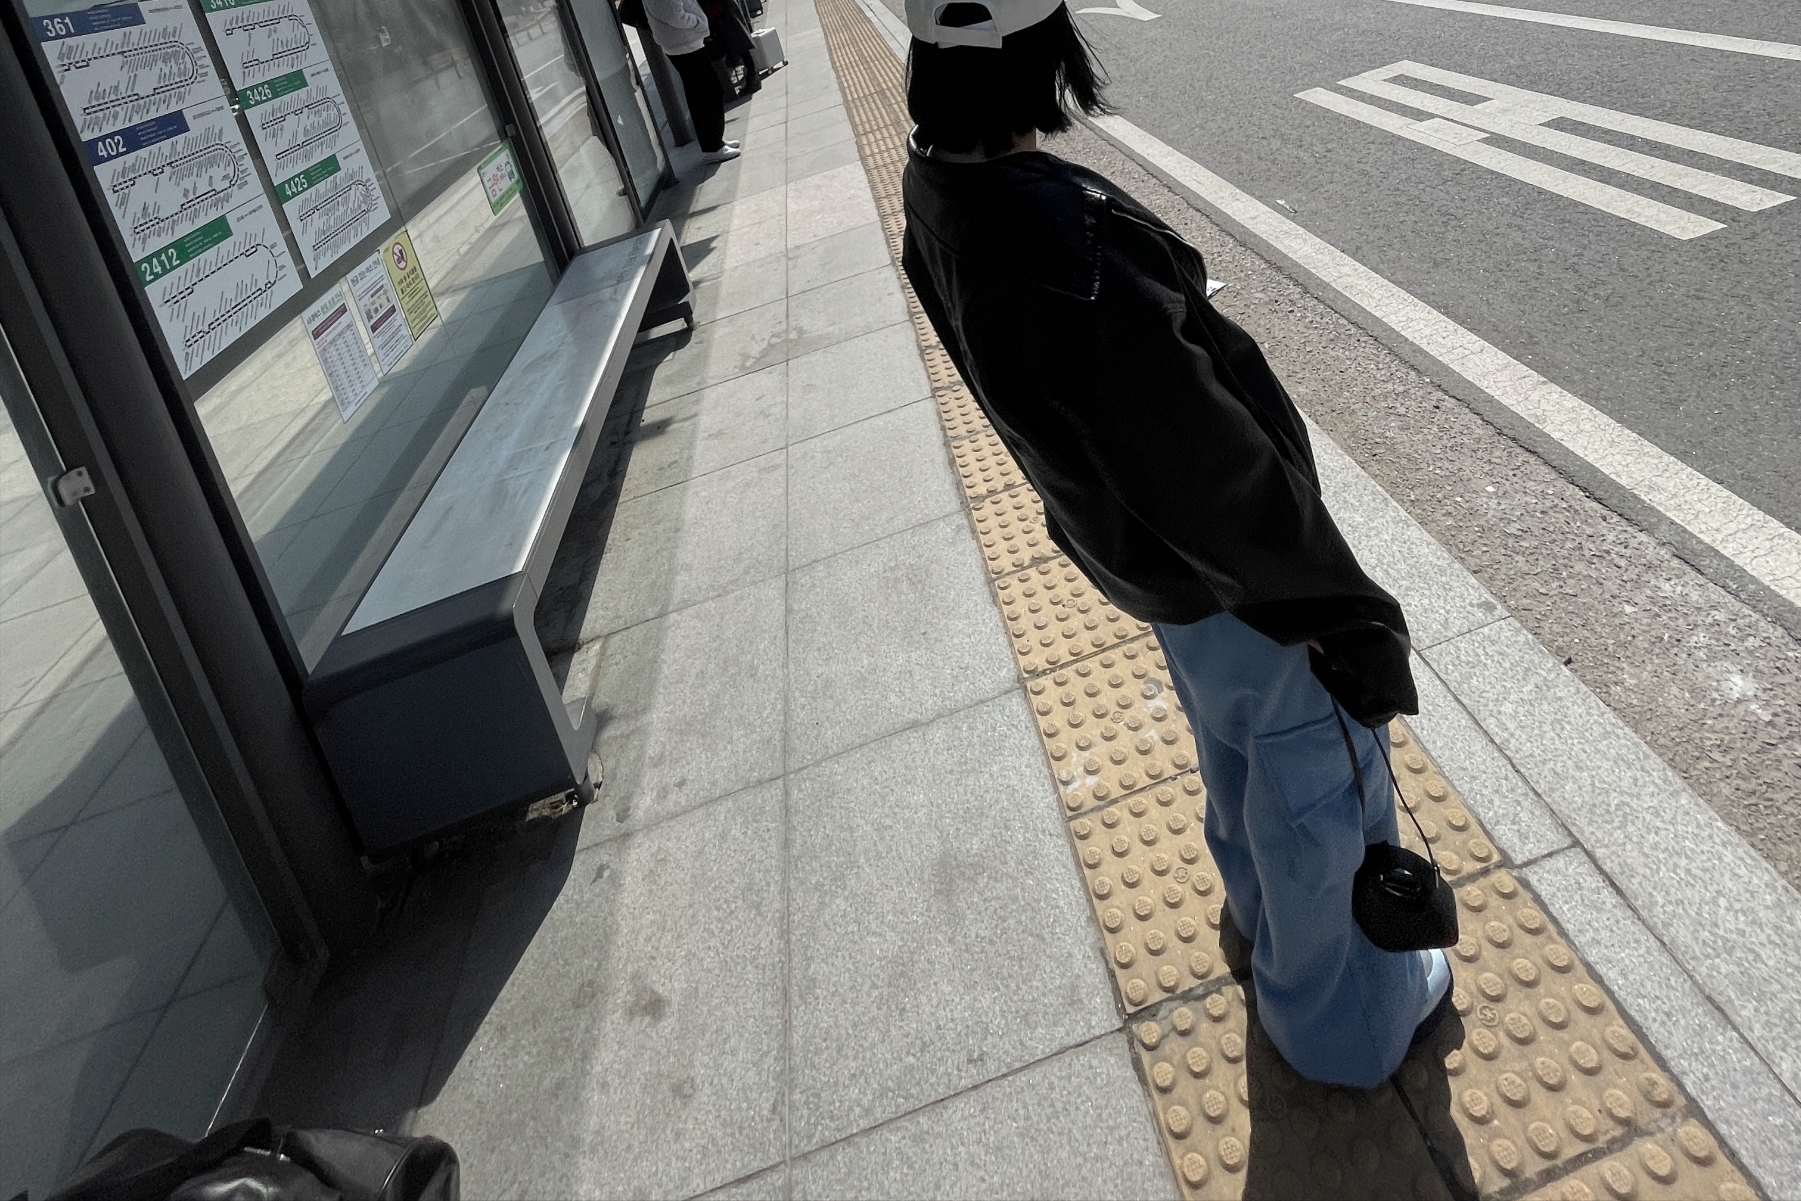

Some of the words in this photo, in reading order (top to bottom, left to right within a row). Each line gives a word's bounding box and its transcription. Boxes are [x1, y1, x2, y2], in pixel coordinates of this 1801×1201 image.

[42, 16, 75, 37] 361
[246, 84, 272, 105] 3426
[97, 135, 127, 159] 402
[284, 174, 308, 197] 4425
[141, 248, 181, 282] 2412
